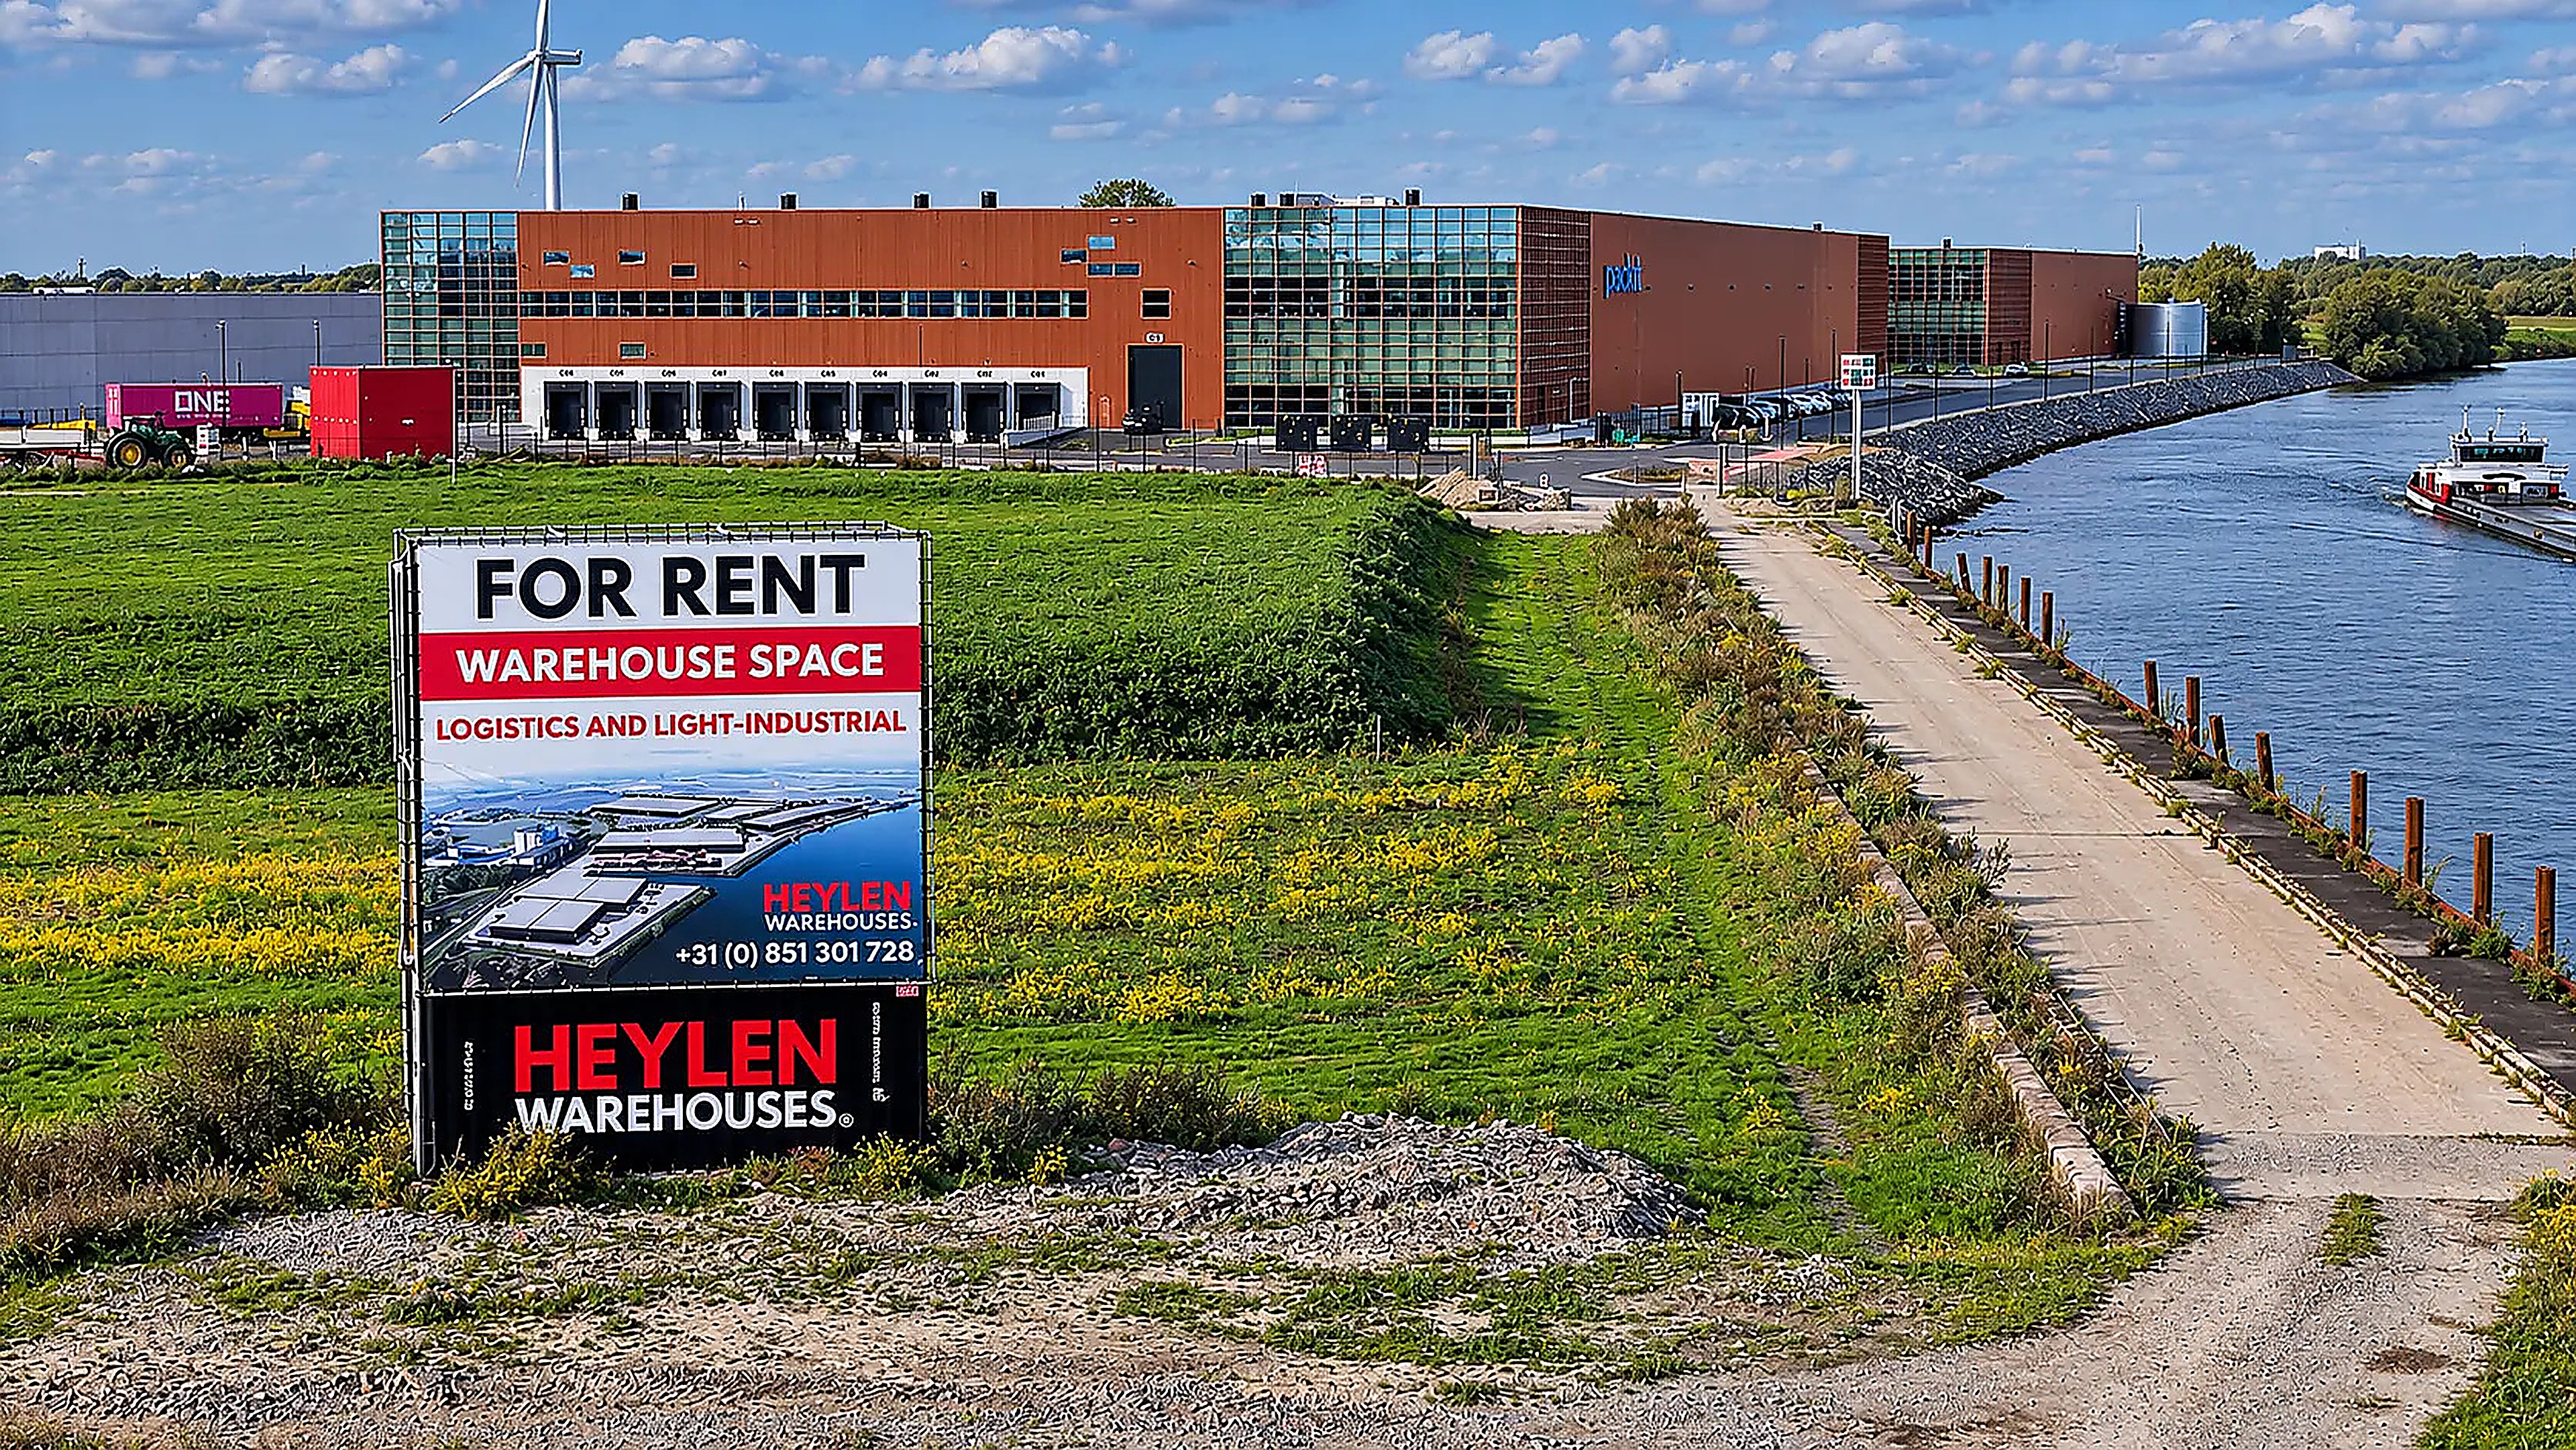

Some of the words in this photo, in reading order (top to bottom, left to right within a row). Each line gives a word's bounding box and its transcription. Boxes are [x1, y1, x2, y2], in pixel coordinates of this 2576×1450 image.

[175, 390, 230, 413] ONE
[476, 557, 637, 620] FOR
[661, 554, 866, 617] RENT
[456, 644, 736, 682] WAREHOUSE
[748, 642, 884, 678] SPACE
[436, 715, 576, 741] LOGISTICS
[585, 715, 647, 737] AND
[654, 709, 908, 737] LIGHT-INDUSTRIAL
[763, 880, 911, 913] HEYLEN
[676, 943, 717, 965] +31
[724, 941, 758, 970] (0)
[765, 942, 807, 964] 851
[815, 941, 859, 963] 301
[865, 940, 914, 962] 728
[514, 1018, 837, 1093] HEYLEN
